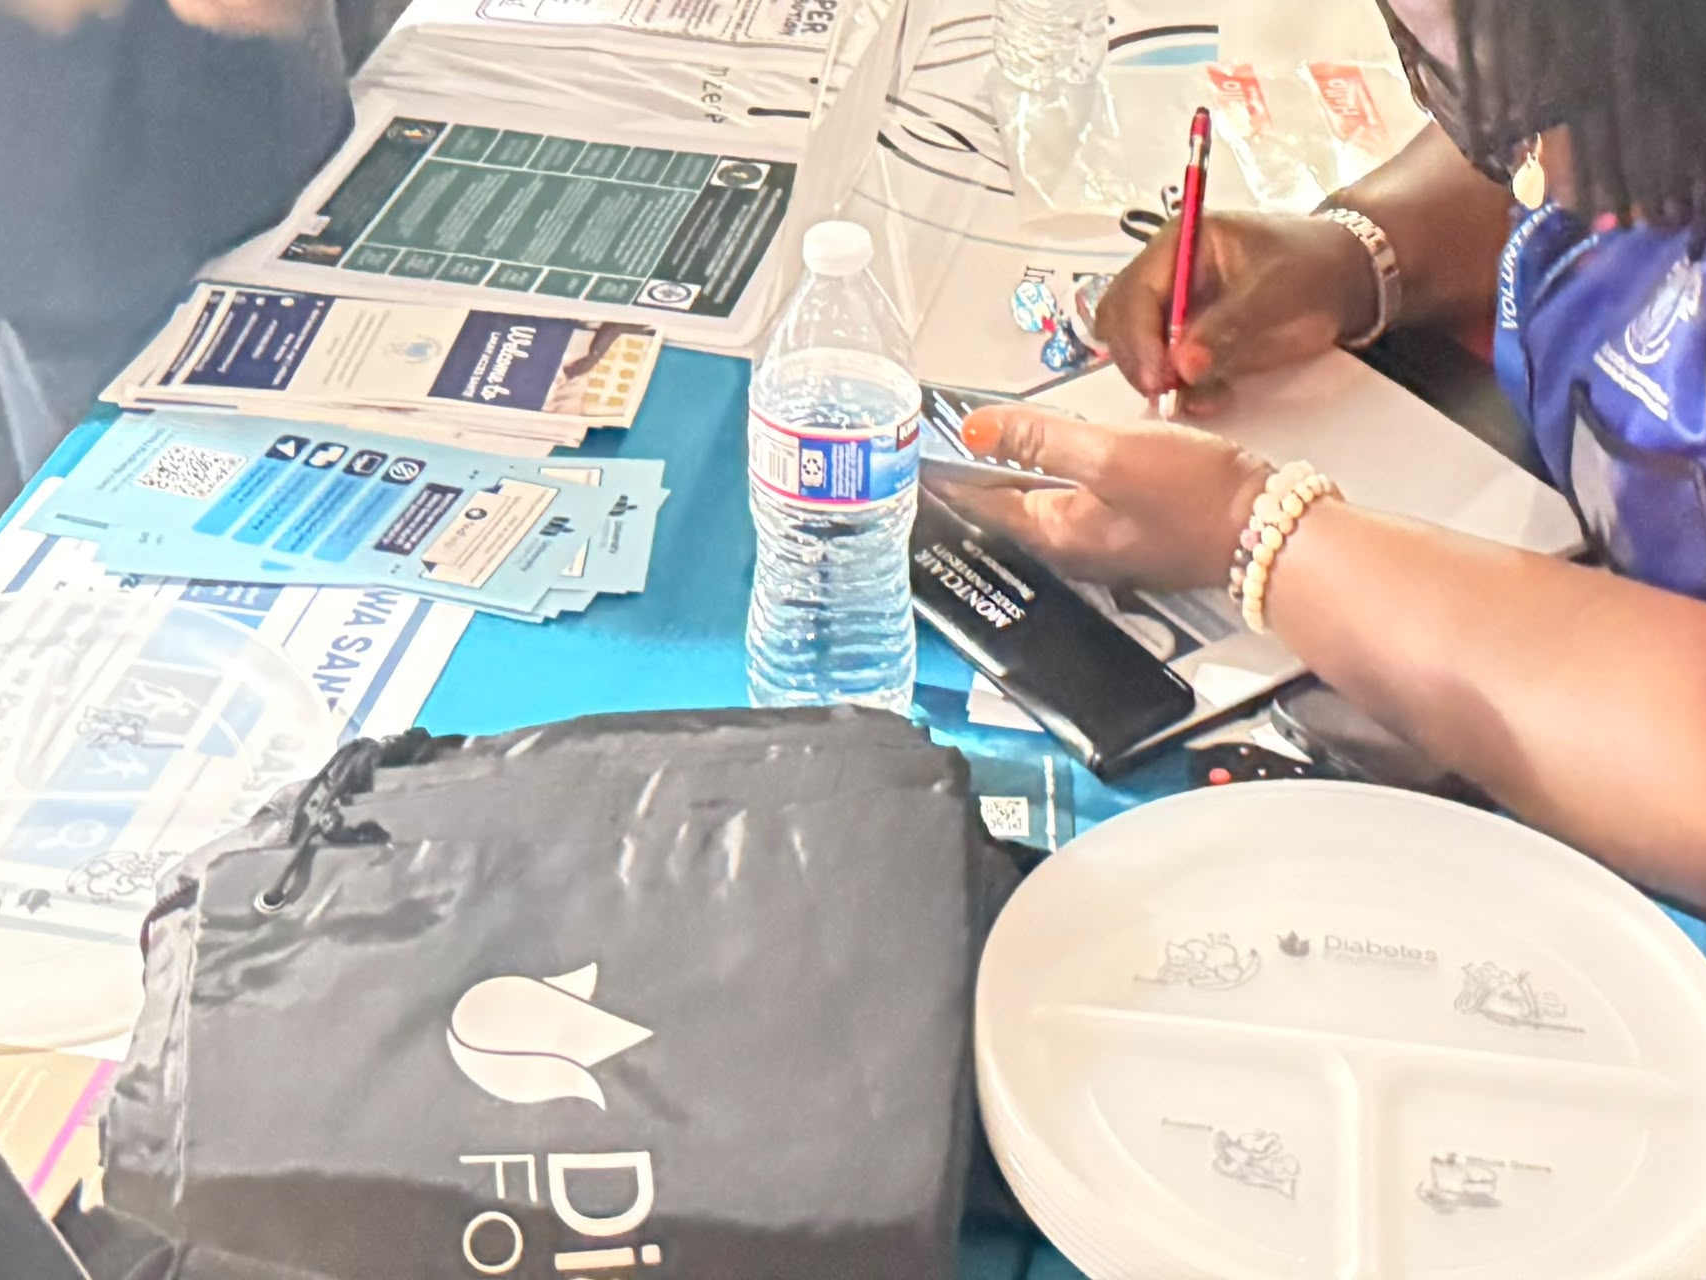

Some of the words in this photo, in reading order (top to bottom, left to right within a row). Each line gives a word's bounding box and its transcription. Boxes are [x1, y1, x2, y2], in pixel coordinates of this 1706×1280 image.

[486, 326, 537, 384] Welcome
[480, 384, 511, 401] to
[914, 549, 1013, 629] MONTCLAIR
[1323, 933, 1438, 963] Diabetes
